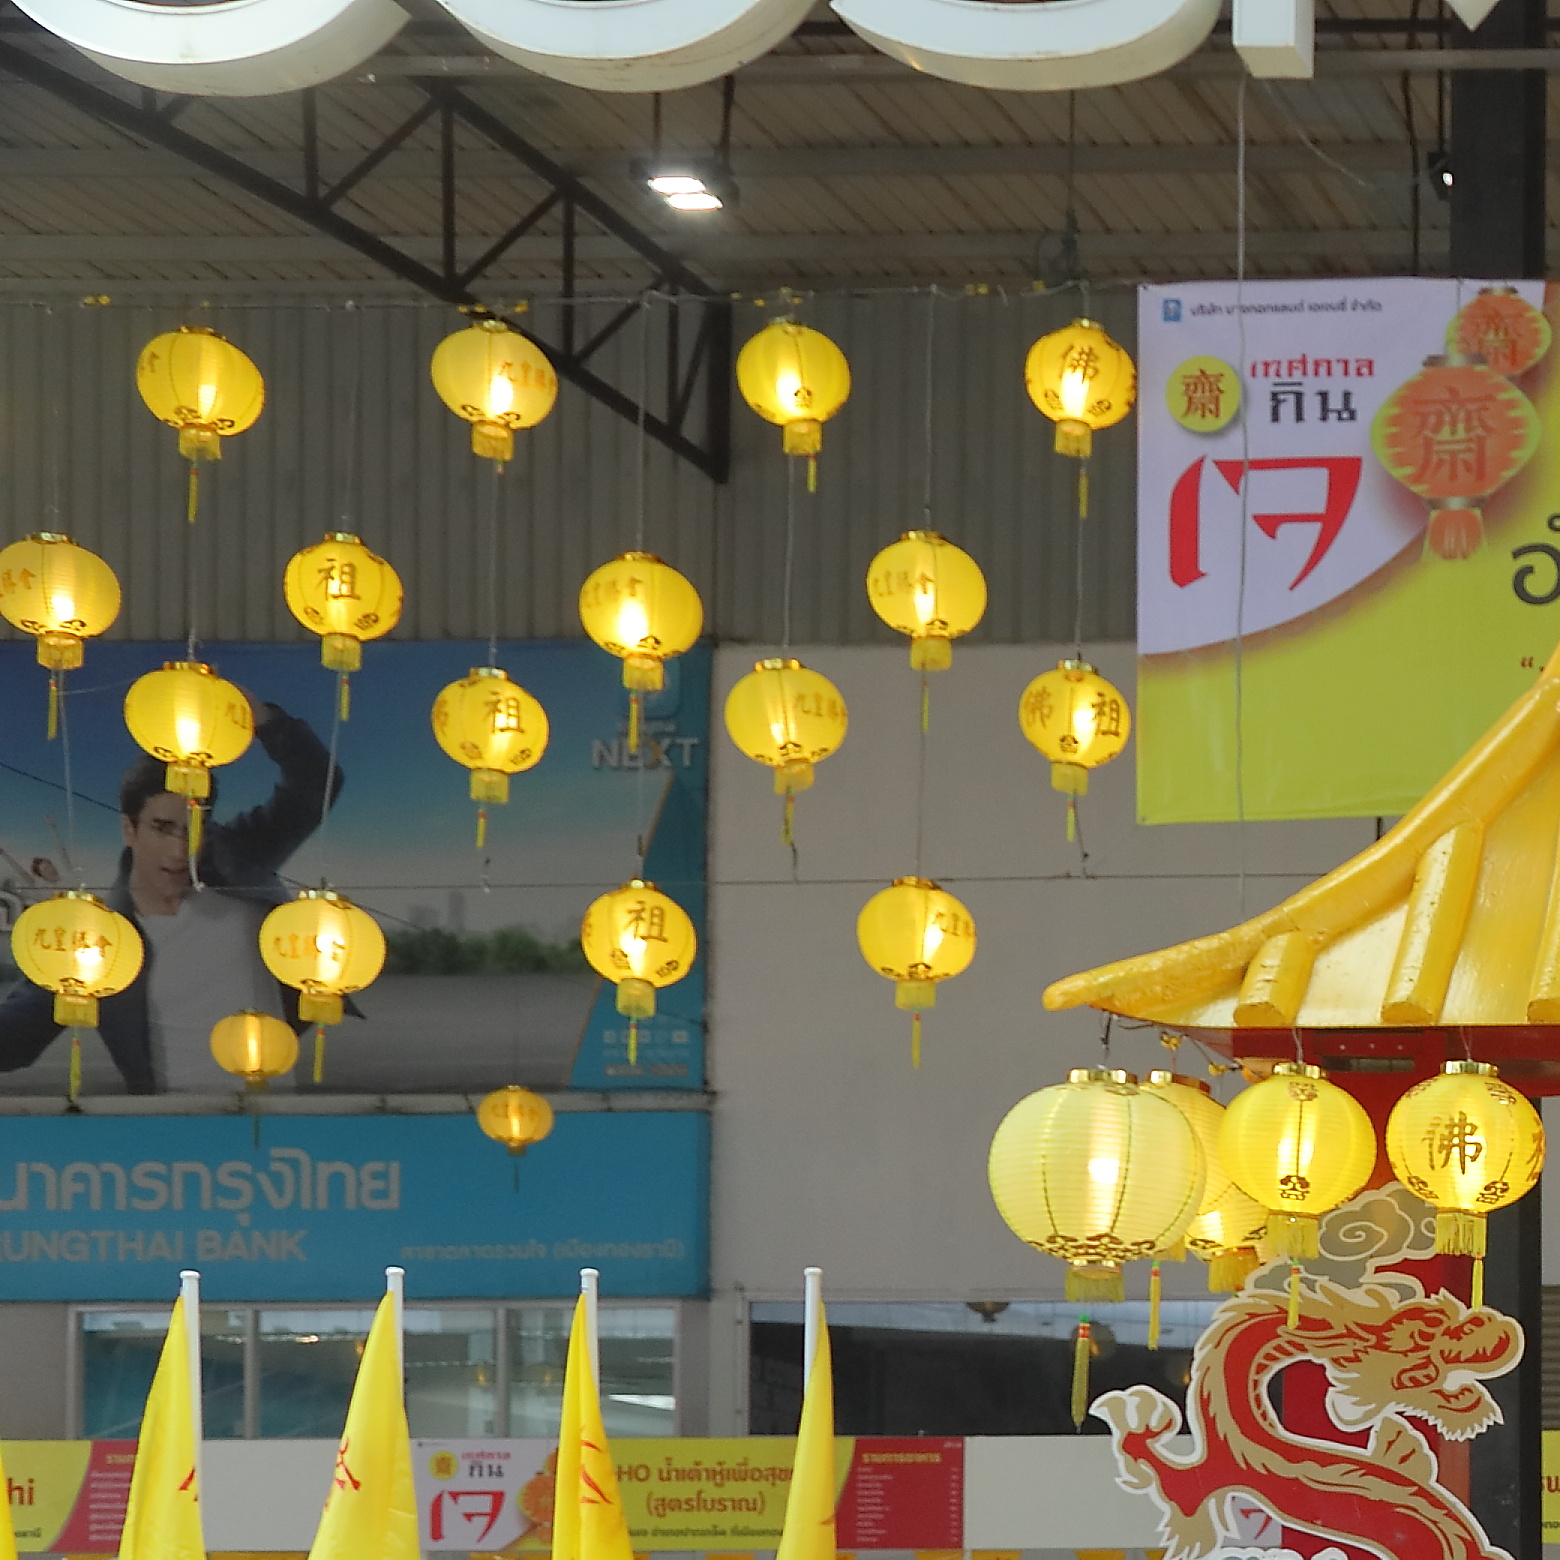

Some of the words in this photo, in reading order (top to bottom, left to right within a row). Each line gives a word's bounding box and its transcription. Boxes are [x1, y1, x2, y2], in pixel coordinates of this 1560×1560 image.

[1059, 345, 1099, 382] 佛
[1250, 353, 1376, 379] เทศกาล
[1269, 381, 1358, 423] กิน
[1168, 455, 1364, 591] เจ
[318, 559, 361, 601] 祖
[485, 690, 524, 733] 祖
[1091, 692, 1122, 738] 祖
[626, 901, 667, 942] 祖
[1421, 1111, 1483, 1175] 佛
[198, 1230, 308, 1263] BANK
[468, 1462, 505, 1479] กิน
[429, 1490, 506, 1543] เจ
